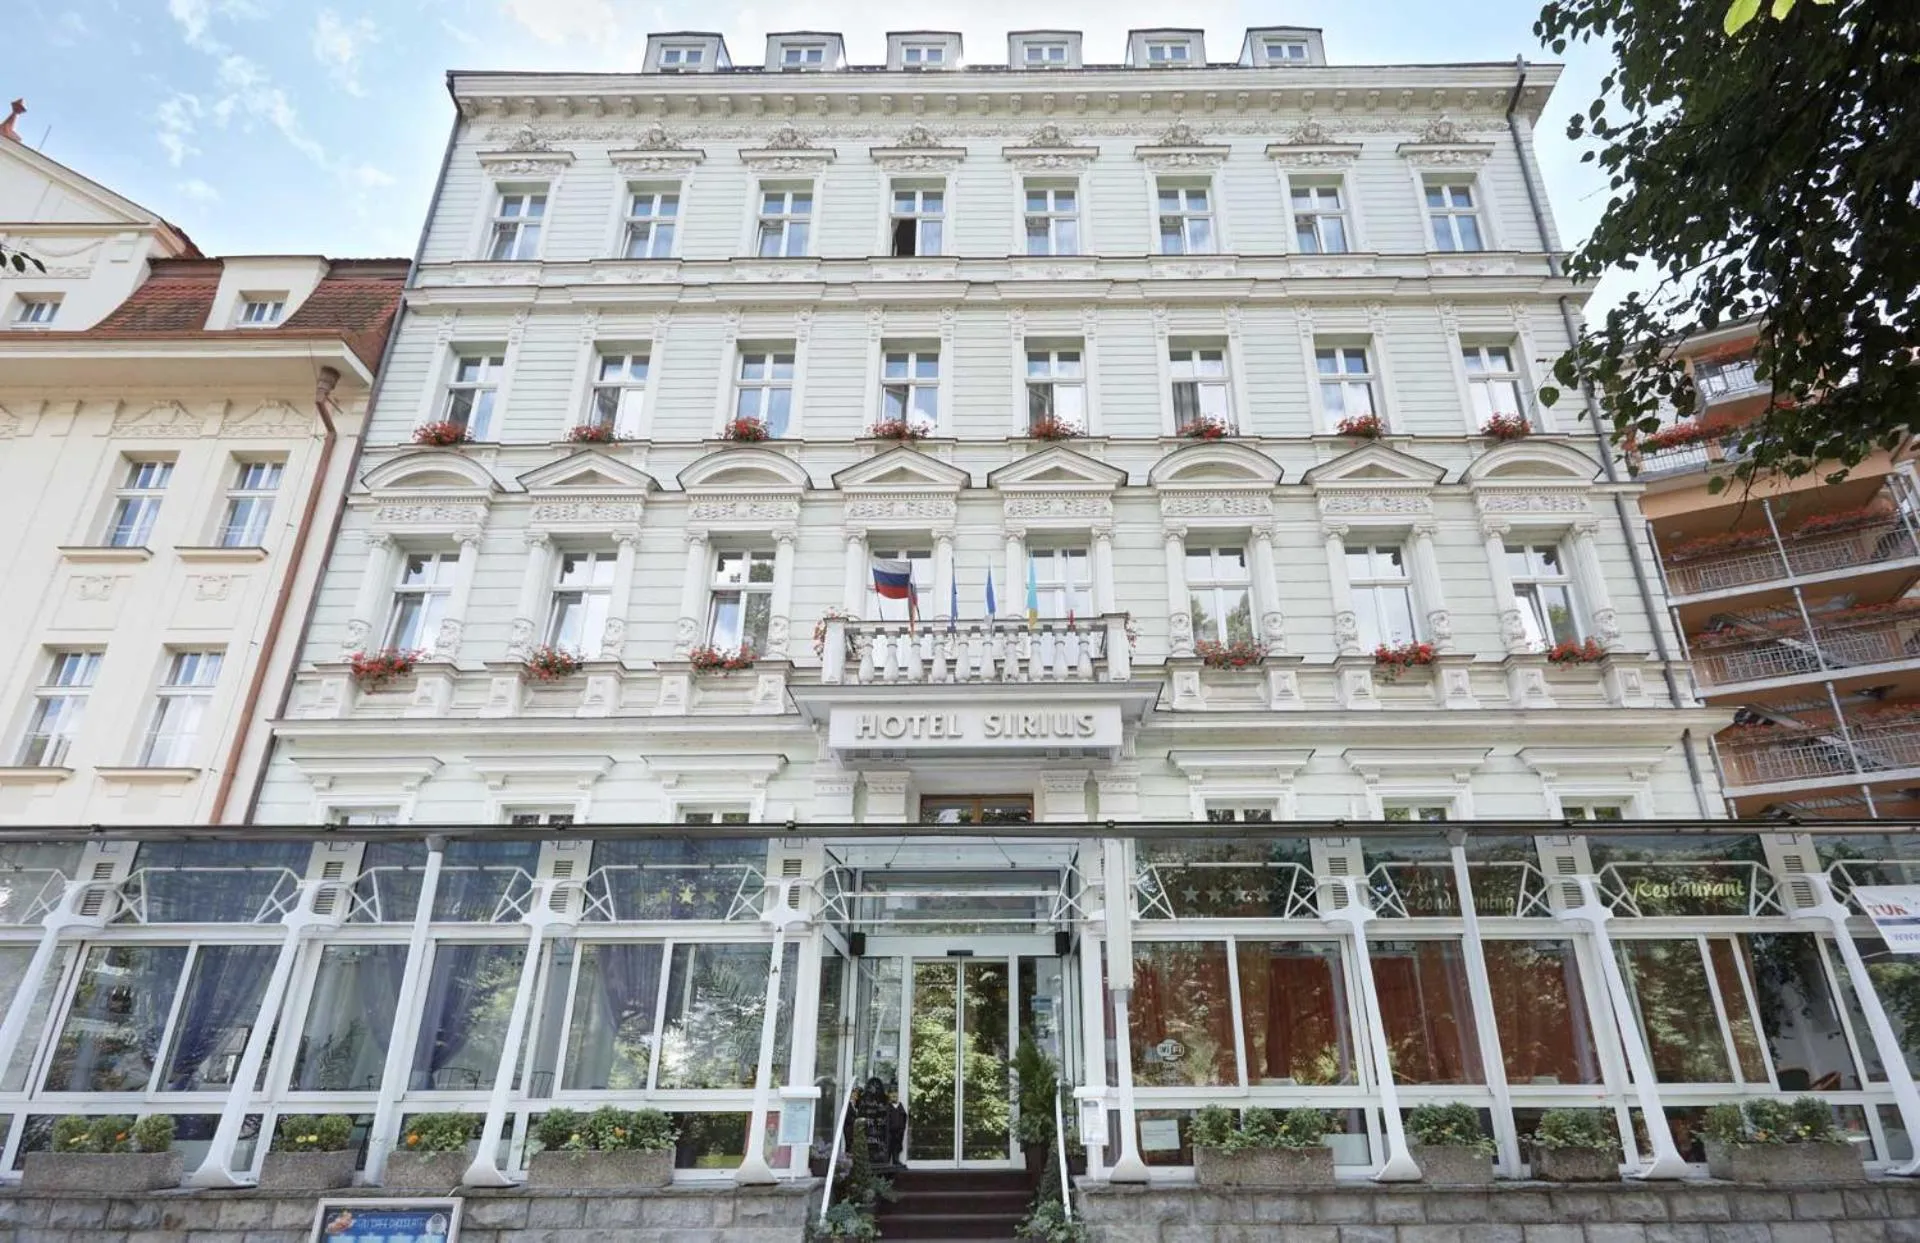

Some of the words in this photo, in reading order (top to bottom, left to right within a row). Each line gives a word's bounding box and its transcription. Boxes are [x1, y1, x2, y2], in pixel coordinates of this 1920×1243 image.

[856, 714, 963, 739] HOTEL
[983, 711, 1096, 739] SIRIUS
[1631, 876, 1746, 902] Restaurant
